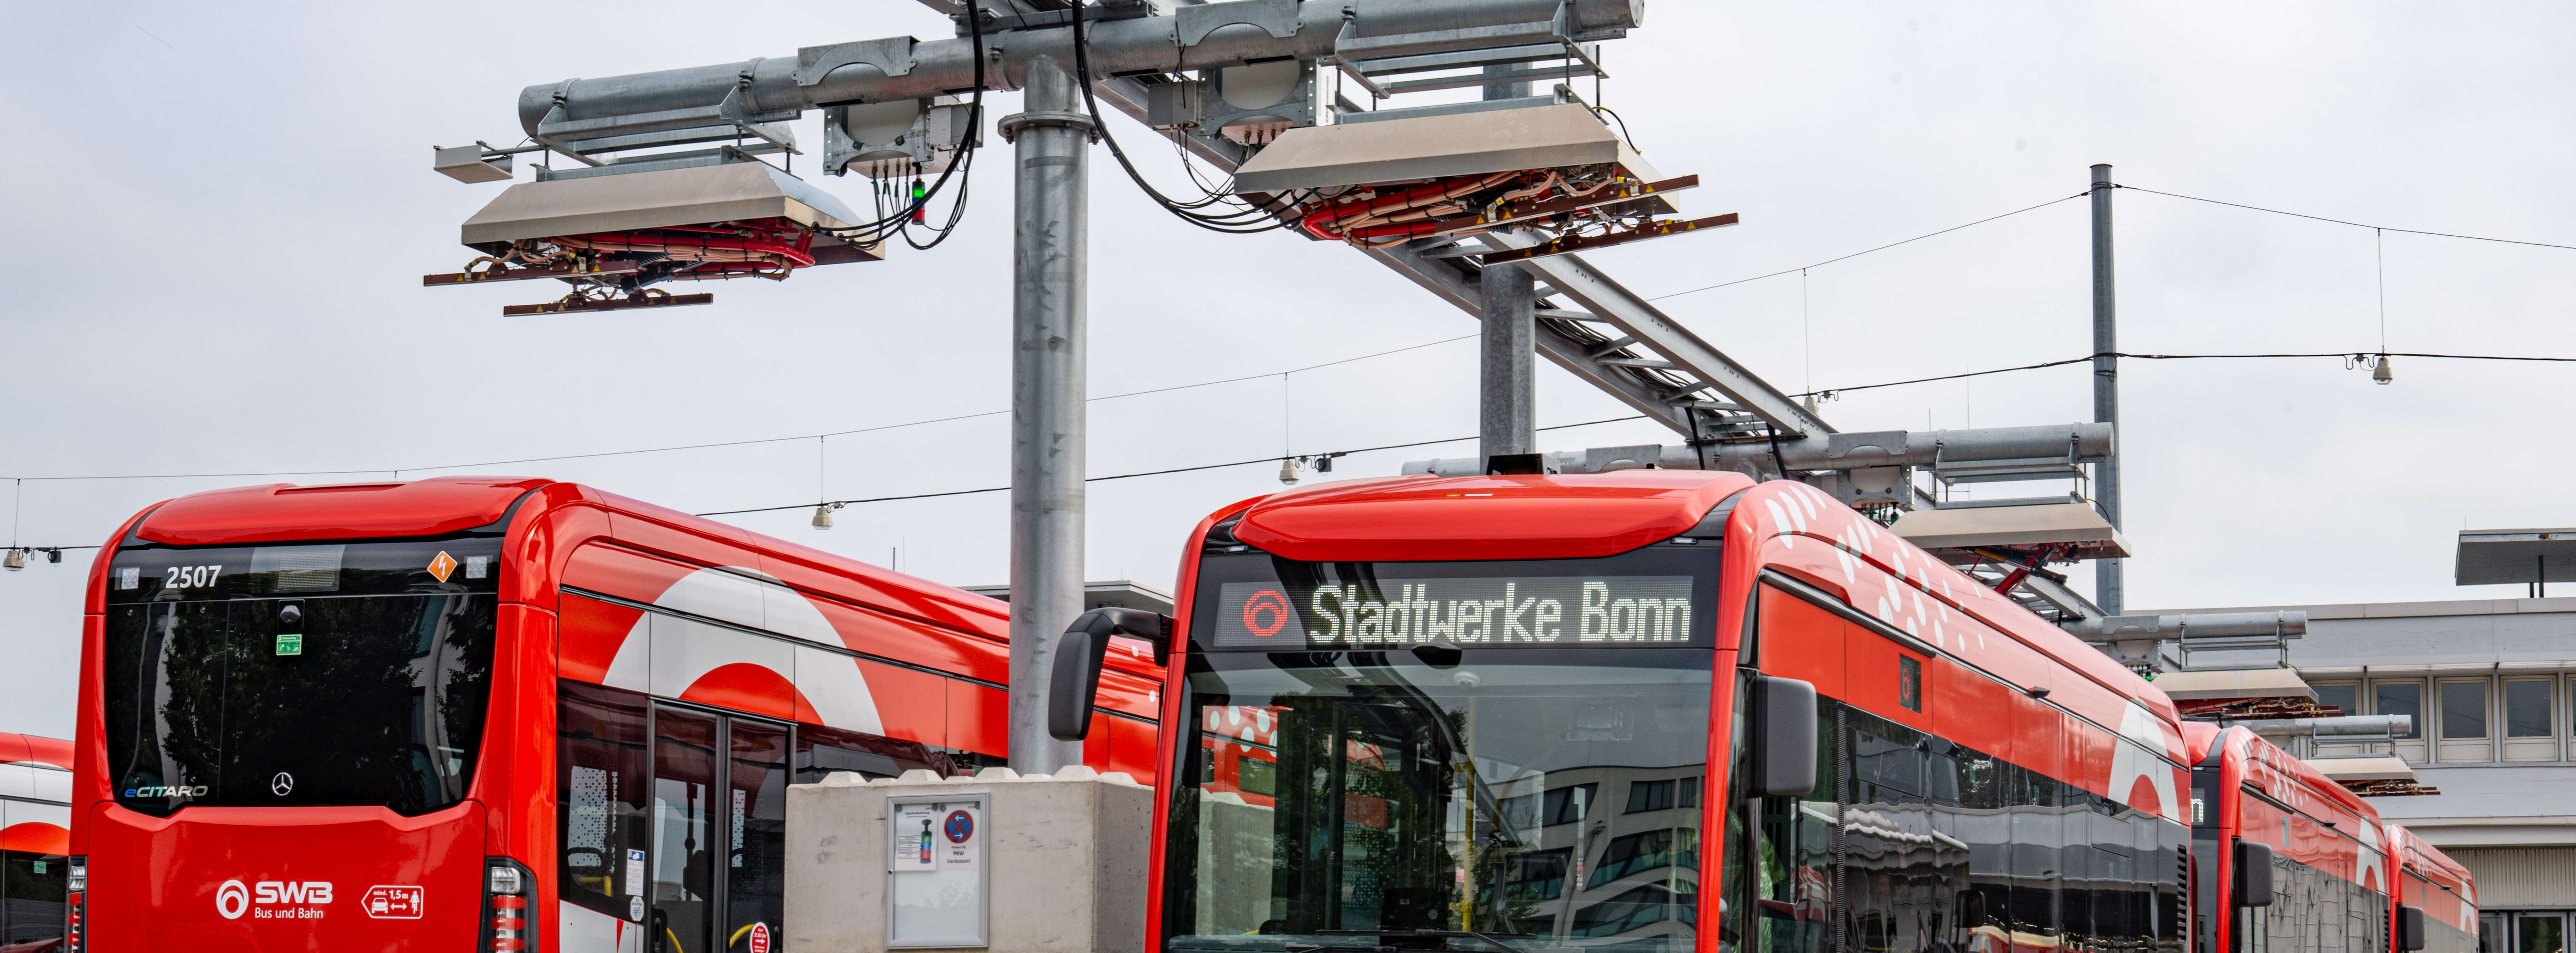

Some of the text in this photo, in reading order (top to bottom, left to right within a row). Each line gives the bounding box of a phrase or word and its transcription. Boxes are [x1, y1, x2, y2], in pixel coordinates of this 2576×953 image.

[165, 565, 222, 588] 2507
[1310, 582, 1691, 643] Stadtwerke Bonn
[124, 786, 208, 797] eCITARO
[255, 881, 333, 904] SWB
[255, 907, 323, 919] Bus und Bahn
